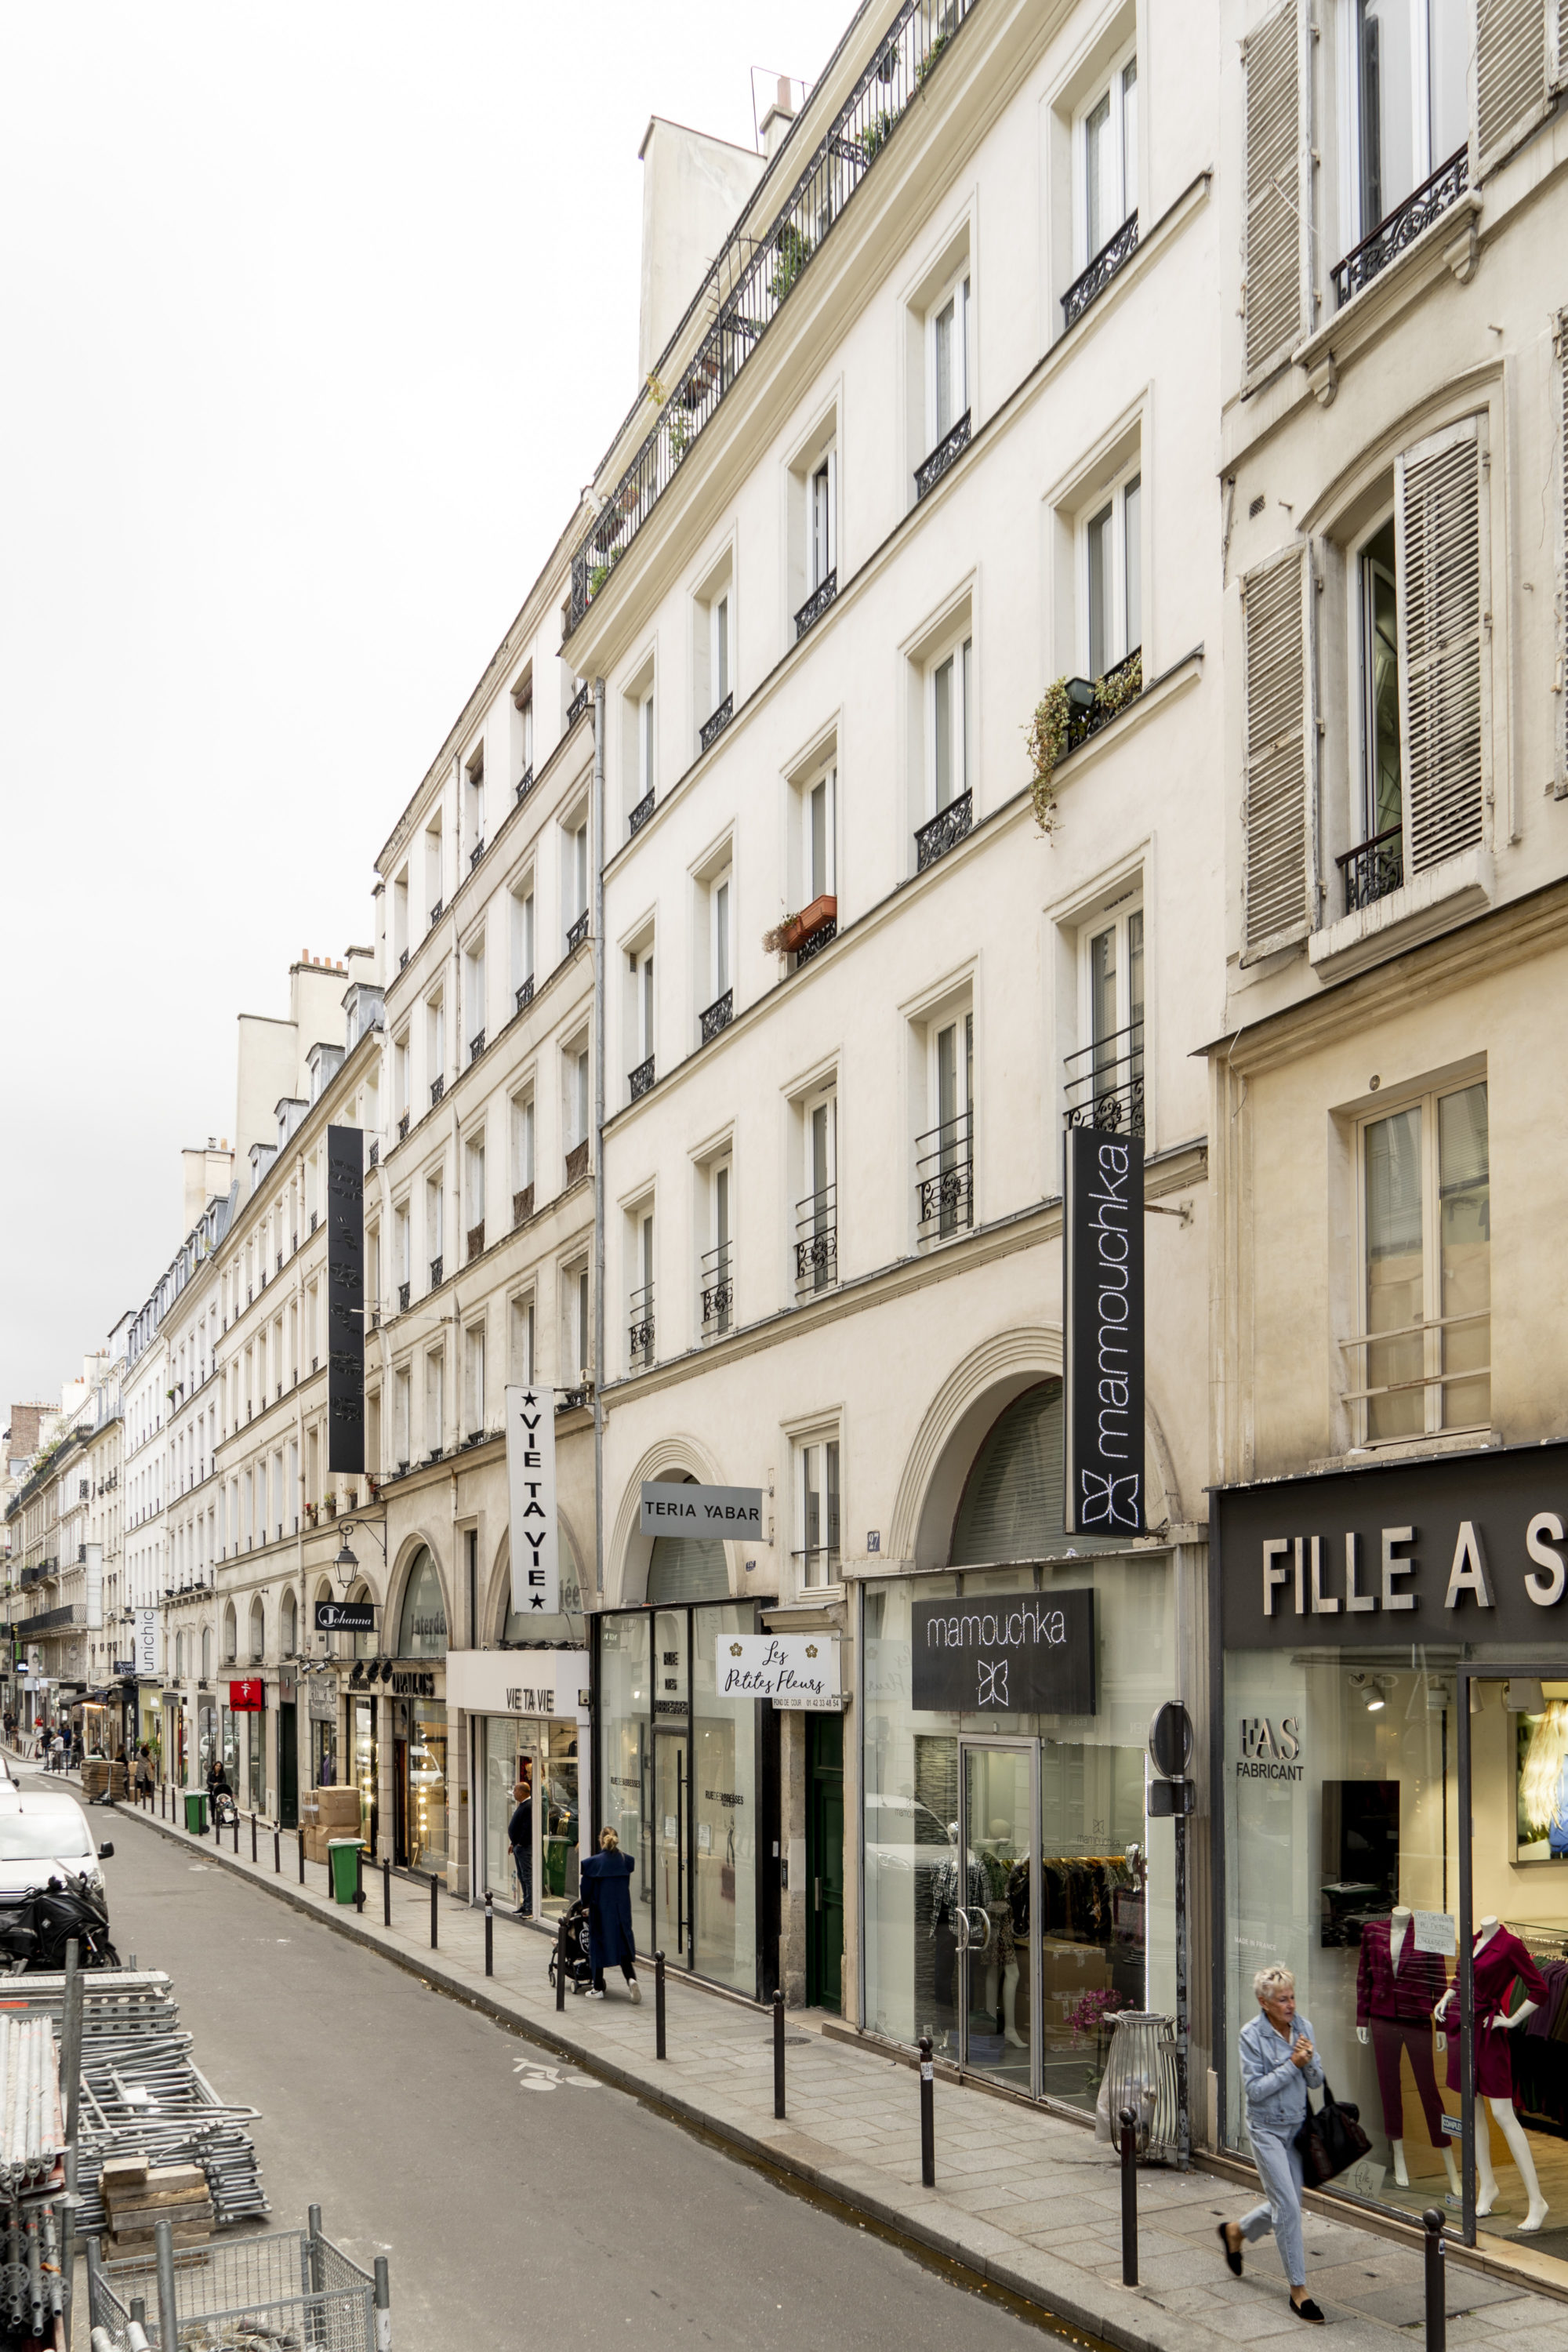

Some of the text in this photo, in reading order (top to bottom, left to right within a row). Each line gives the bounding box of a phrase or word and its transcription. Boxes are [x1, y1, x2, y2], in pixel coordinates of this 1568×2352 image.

[1088, 1144, 1129, 1459] mamouchka
[520, 1414, 546, 1586] VIE TA VIE
[644, 1501, 760, 1521] TERIA YABAR
[869, 1533, 879, 1550] 27
[1263, 1526, 1418, 1615] FILLE
[1444, 1521, 1494, 1608] A
[318, 1606, 372, 1628] Johanna
[927, 1602, 1066, 1648] mamouchka
[140, 1611, 154, 1671] unichic
[762, 1640, 789, 1666] Les
[724, 1668, 826, 1694] Petites Fleurs
[506, 1688, 554, 1712] VIE TA VIE
[1236, 1762, 1304, 1780] FABRICANT
